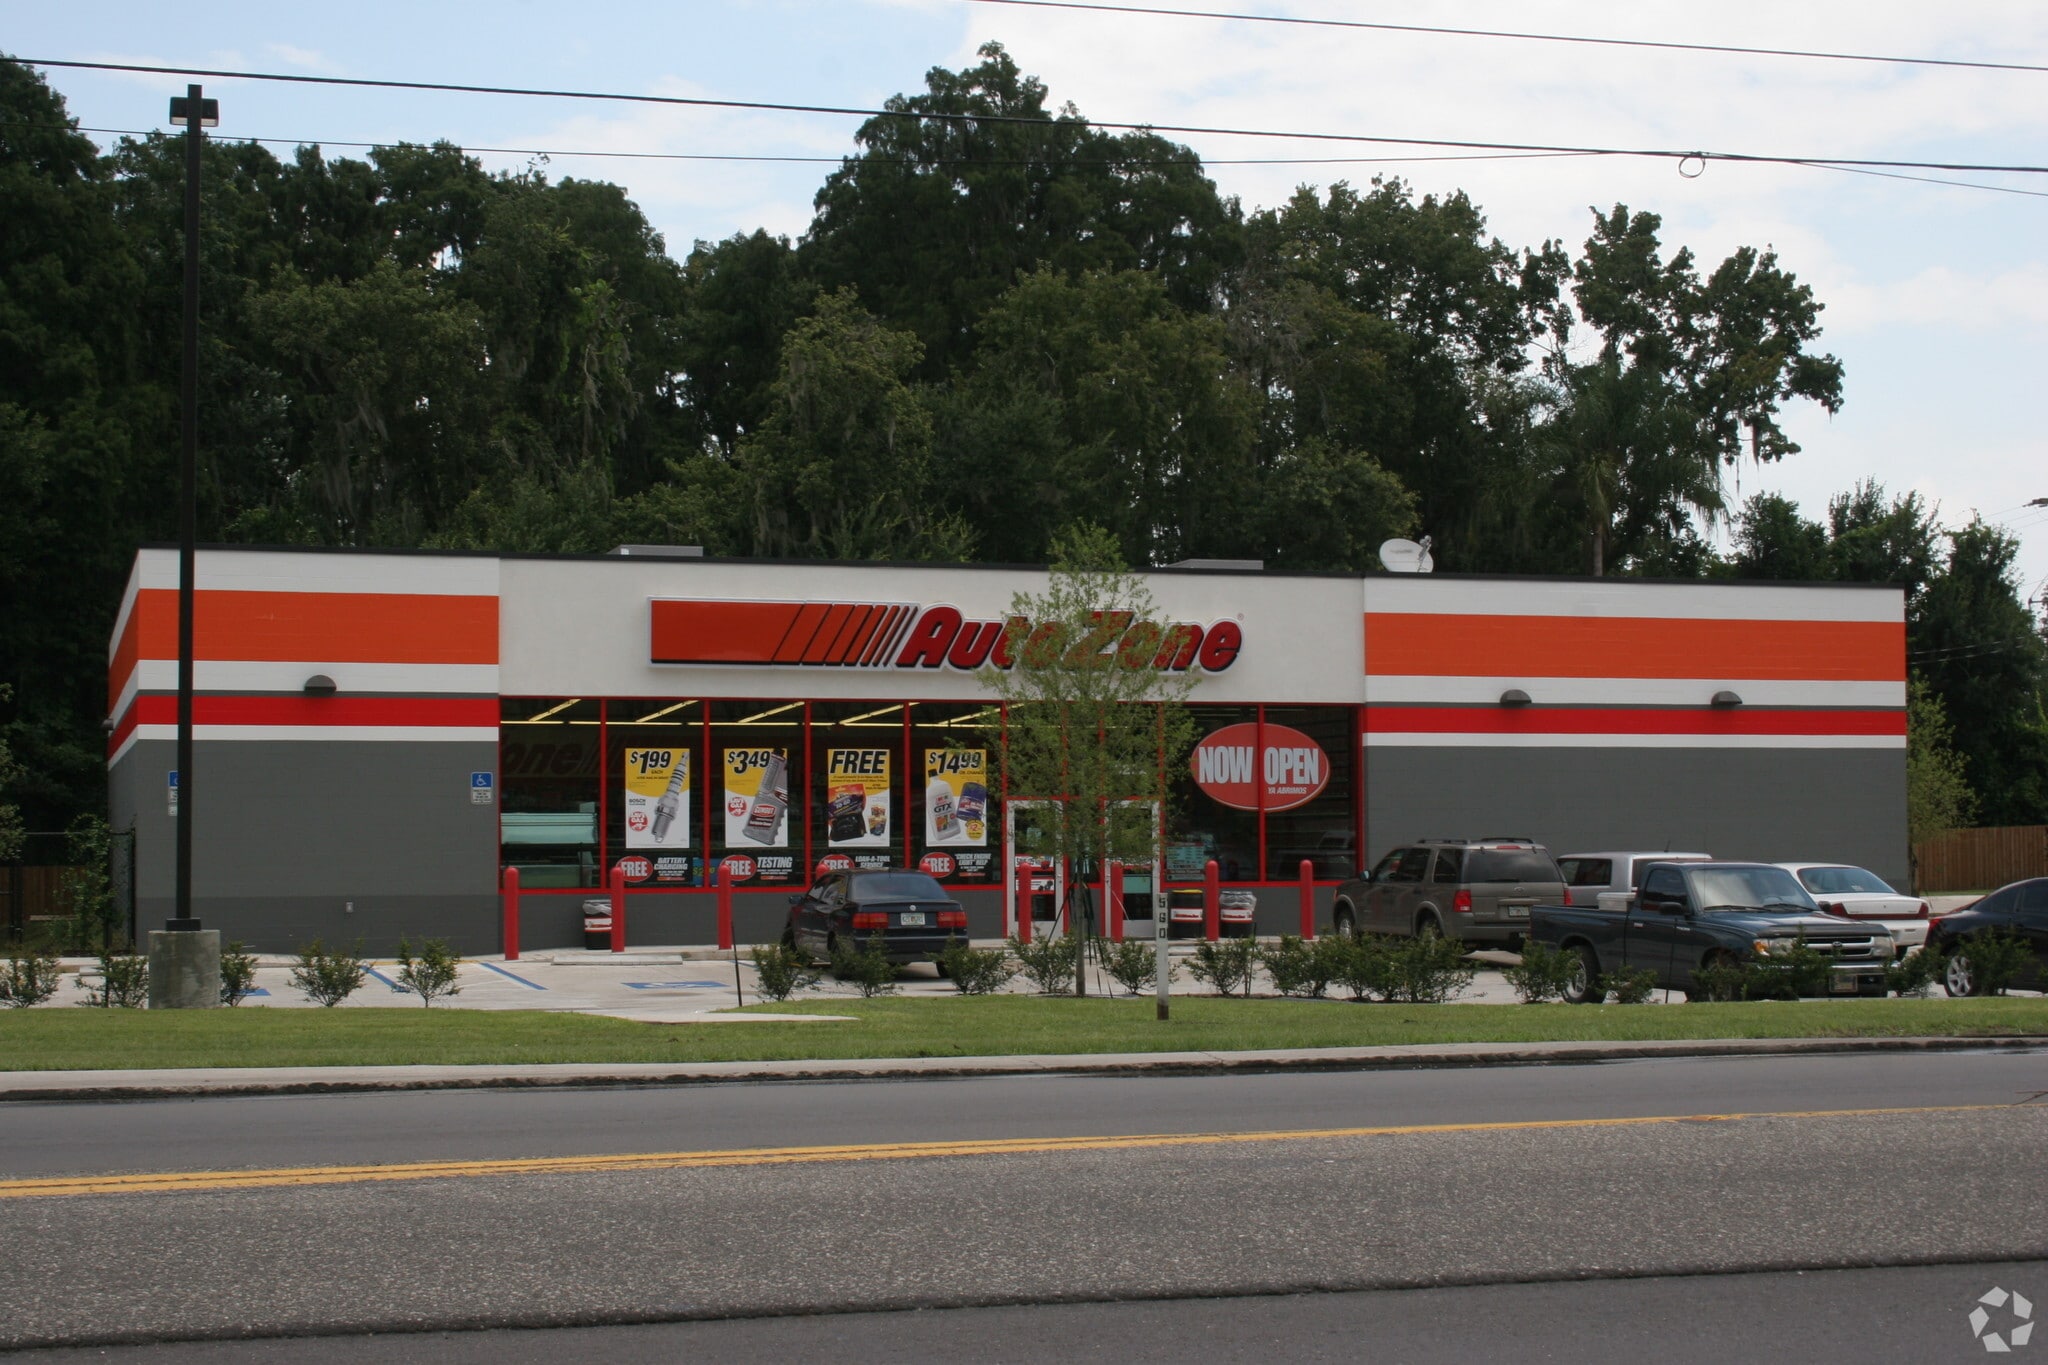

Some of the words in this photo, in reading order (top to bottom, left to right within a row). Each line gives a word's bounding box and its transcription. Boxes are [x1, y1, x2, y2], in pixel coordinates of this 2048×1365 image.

[896, 606, 1243, 672] AutoZone
[830, 751, 887, 774] FREE
[1199, 746, 1254, 784] NOW
[1264, 747, 1319, 785] OPEN
[934, 802, 953, 813] GTX
[621, 861, 648, 877] FREE
[757, 857, 793, 868] TESTING
